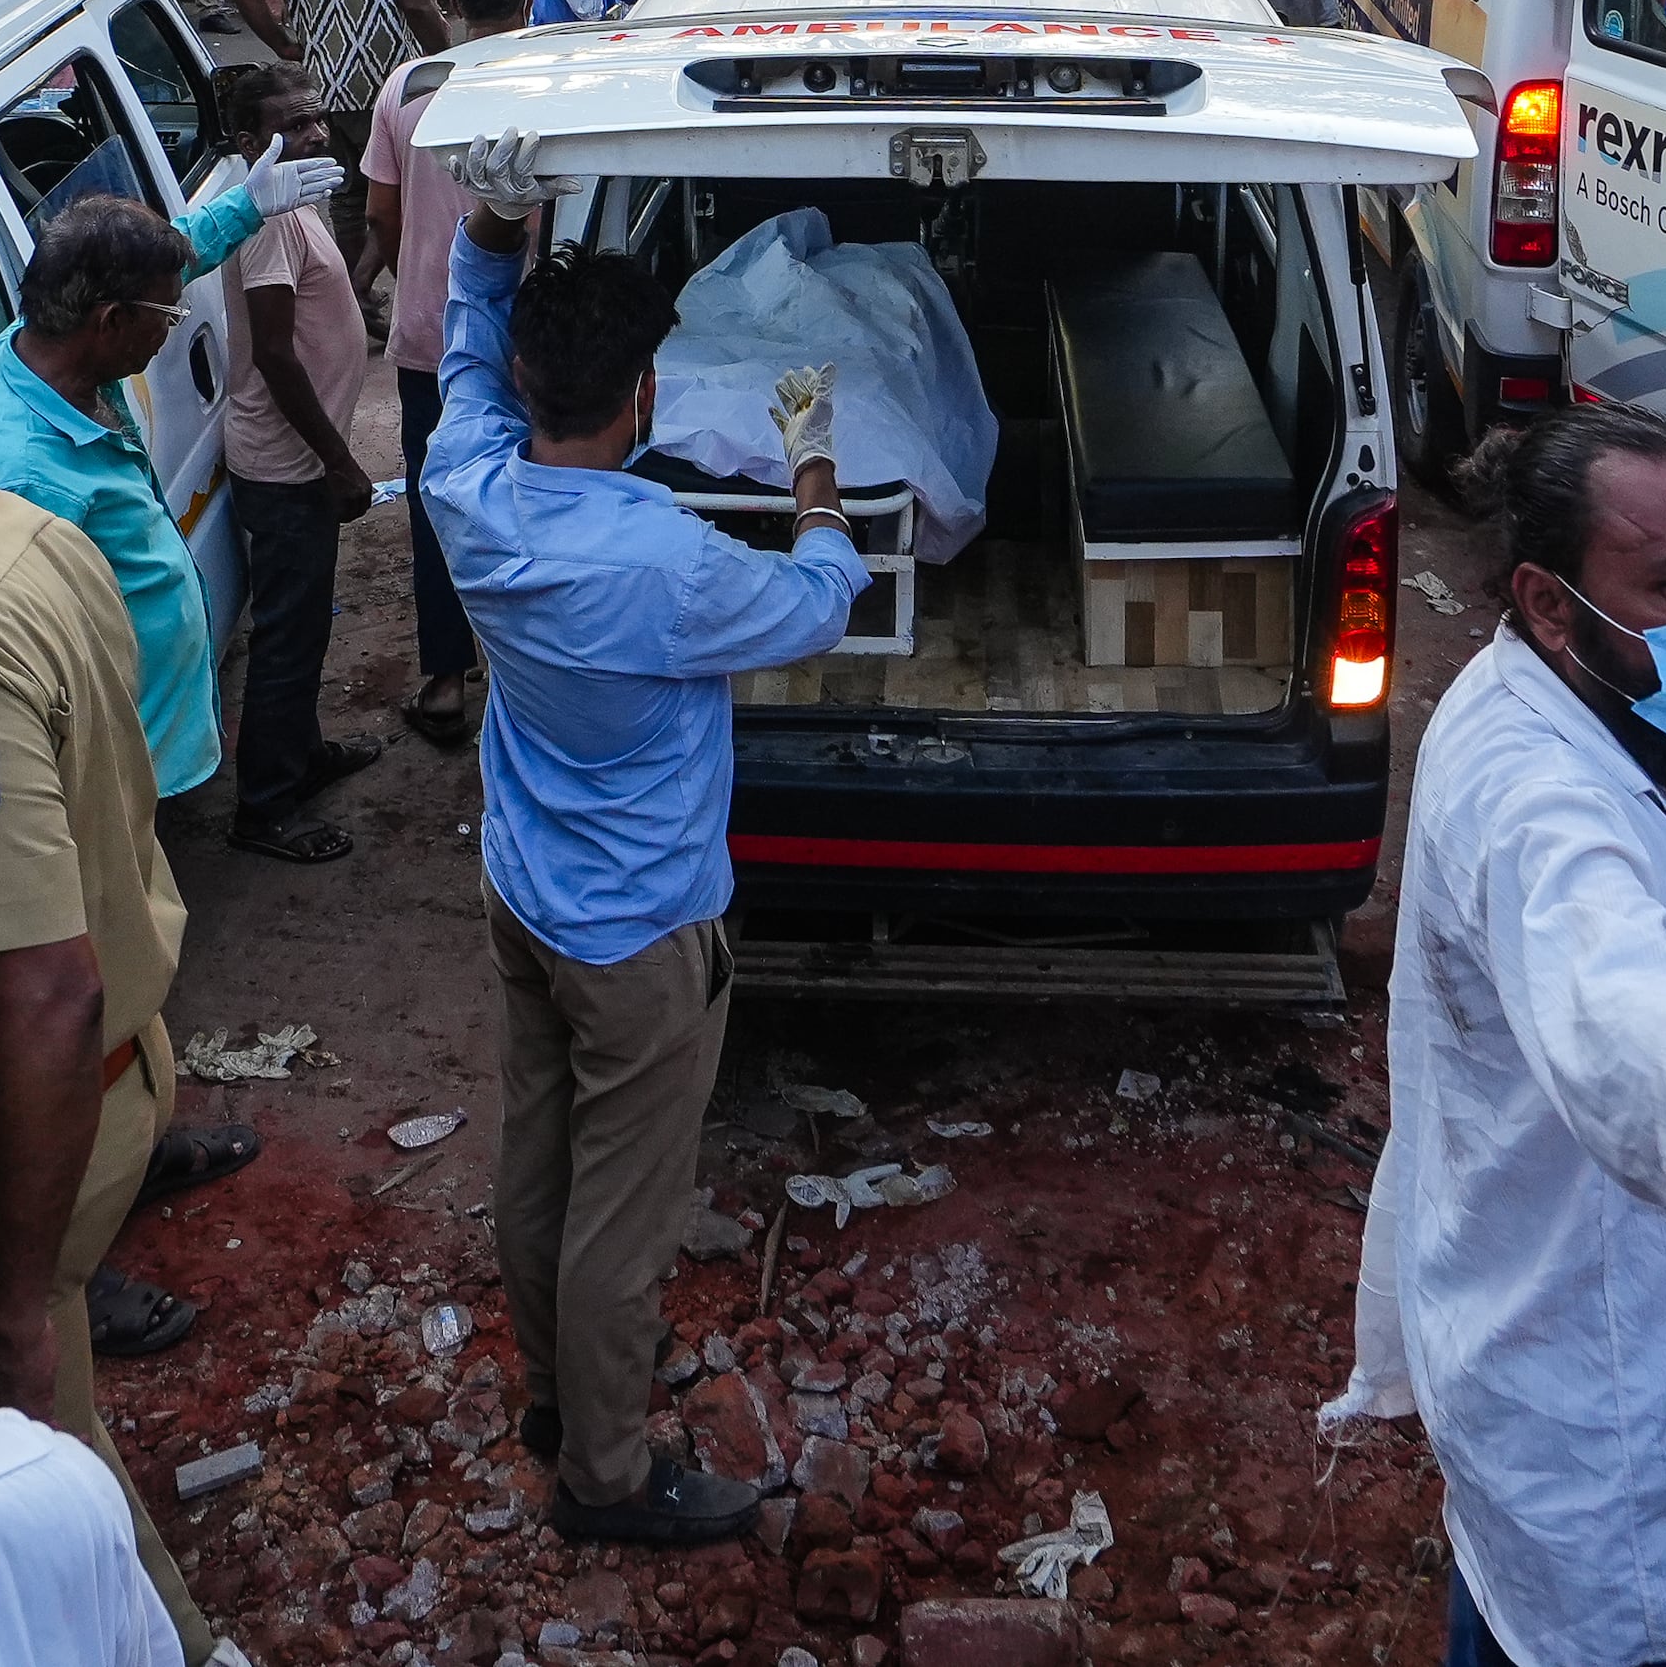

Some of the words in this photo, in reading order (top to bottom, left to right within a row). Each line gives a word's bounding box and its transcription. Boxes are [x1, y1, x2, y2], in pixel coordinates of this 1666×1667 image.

[674, 22, 1219, 42] AMBULANCE
[1576, 172, 1589, 200] A
[1596, 179, 1651, 227] Bosch
[1560, 258, 1630, 305] FORCE
